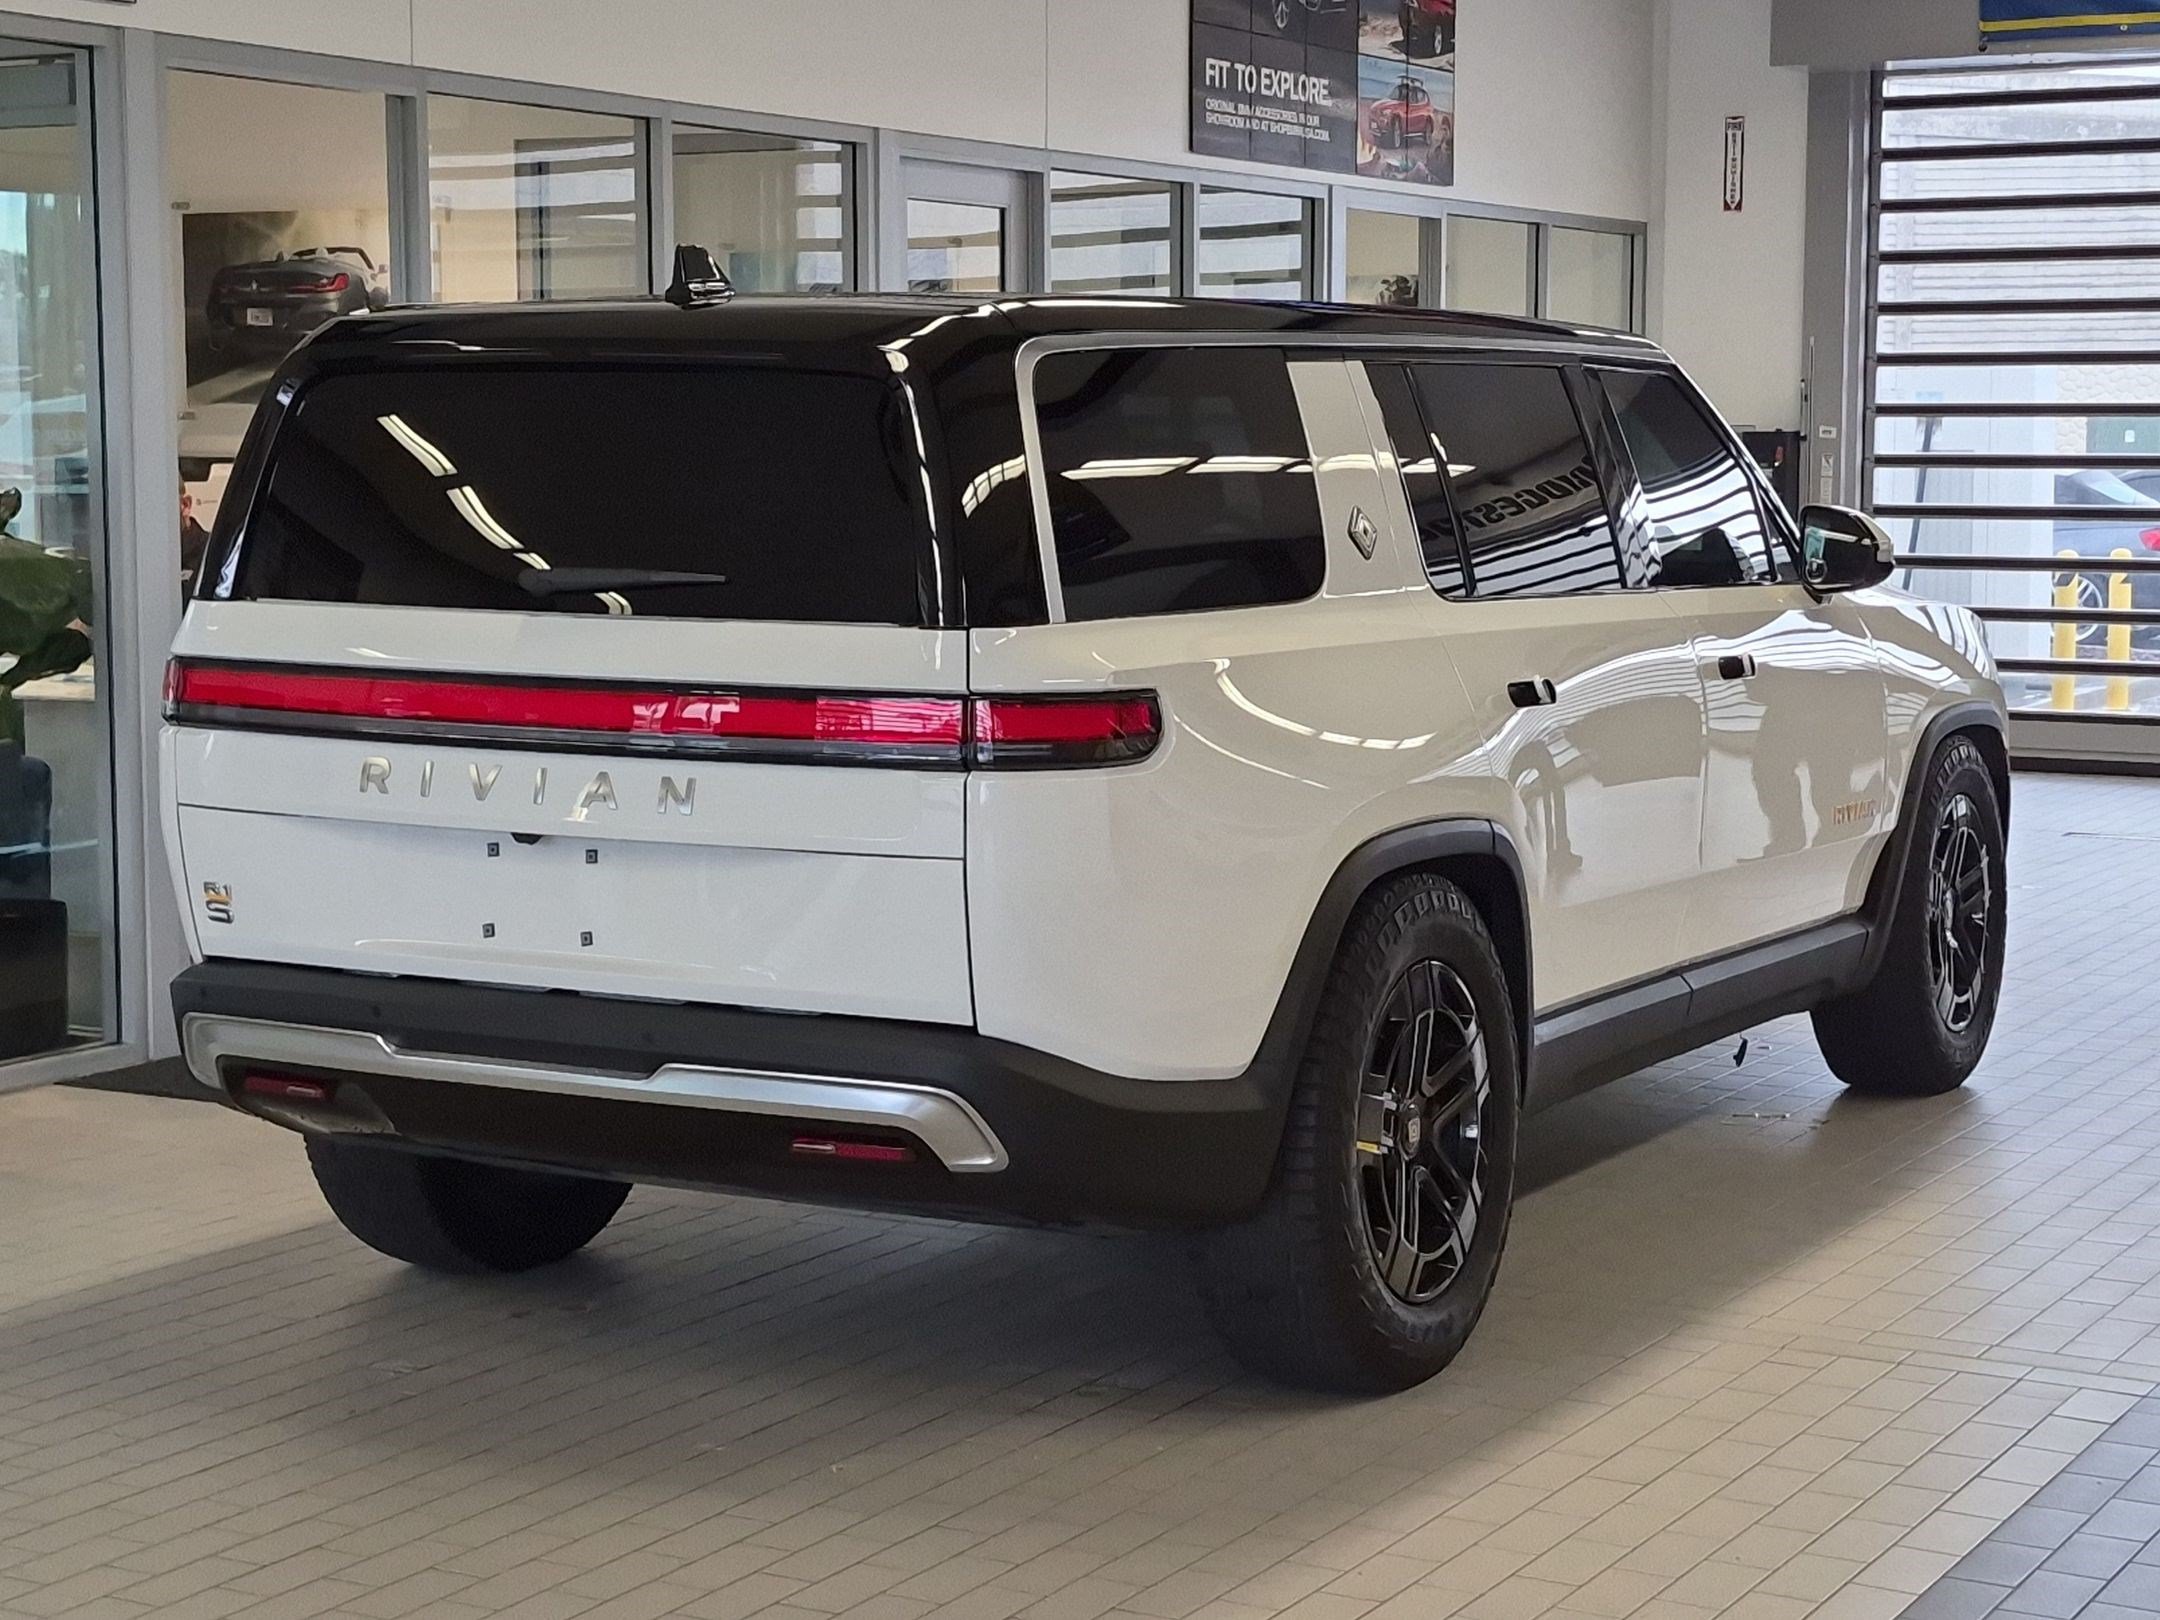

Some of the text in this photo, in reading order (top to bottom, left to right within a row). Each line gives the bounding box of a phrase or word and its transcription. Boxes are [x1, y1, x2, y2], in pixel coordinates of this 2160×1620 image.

[1205, 57, 1231, 89] FIT
[1234, 62, 1257, 94] TO
[359, 755, 697, 817] RIVIAN
